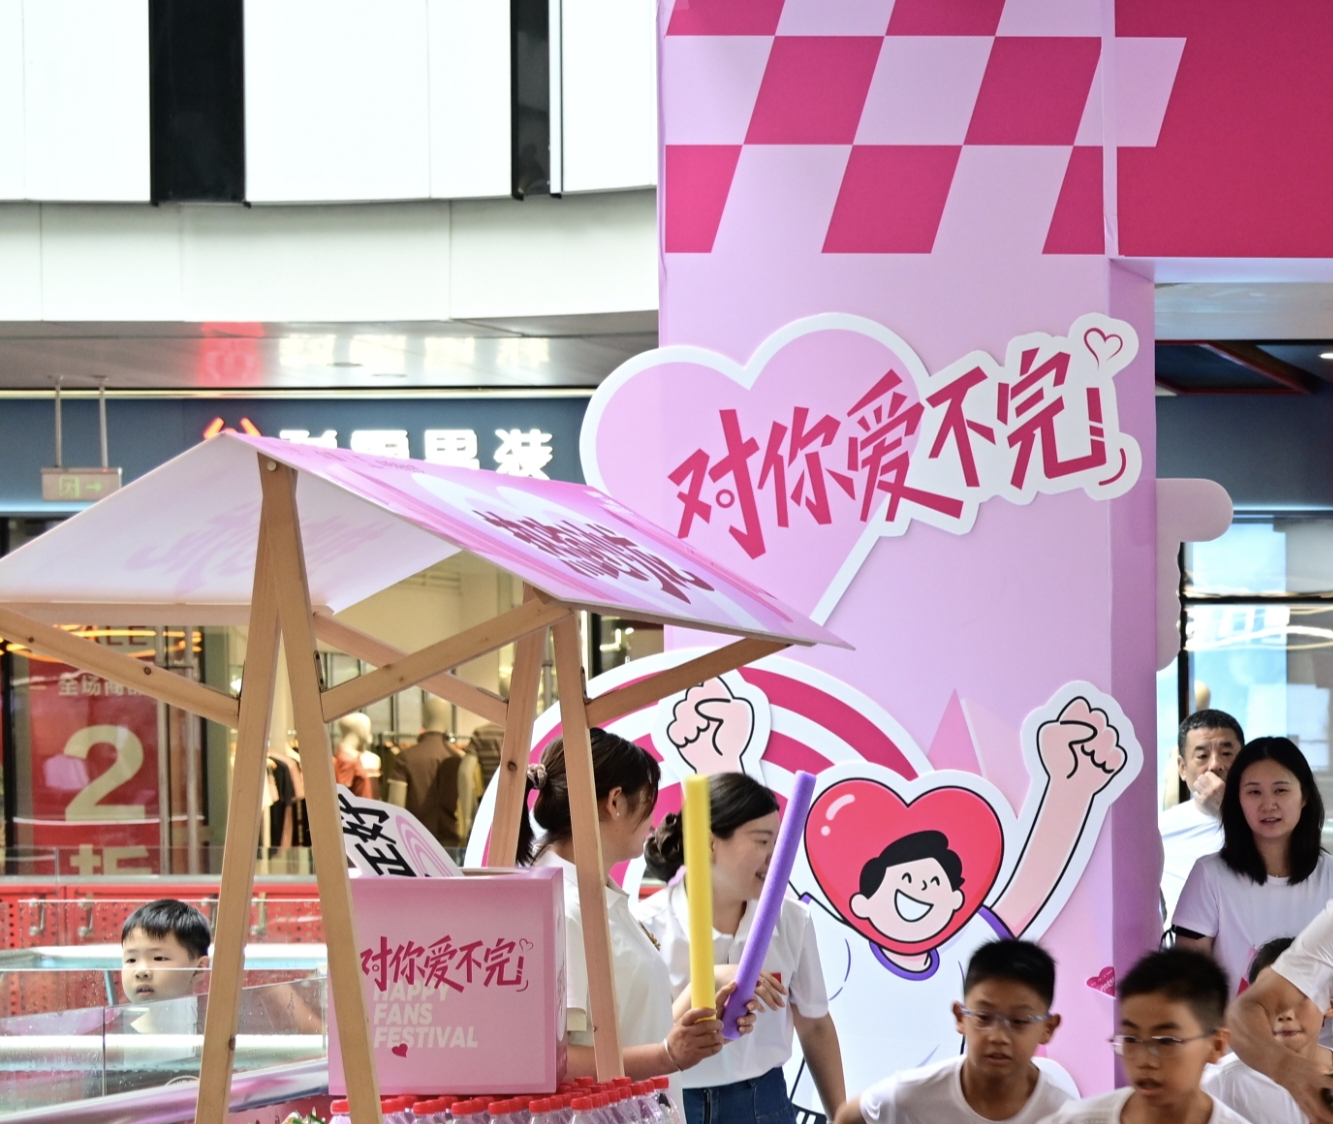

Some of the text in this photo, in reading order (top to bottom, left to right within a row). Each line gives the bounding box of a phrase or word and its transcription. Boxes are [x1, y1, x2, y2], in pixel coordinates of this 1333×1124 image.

[668, 347, 1108, 561] 对你爱不完
[63, 723, 146, 822] 2
[359, 934, 529, 994] 对你爱不完
[373, 979, 450, 1002] HAPPY
[373, 1003, 434, 1026] FANS
[373, 1026, 479, 1049] FESTIVAL
